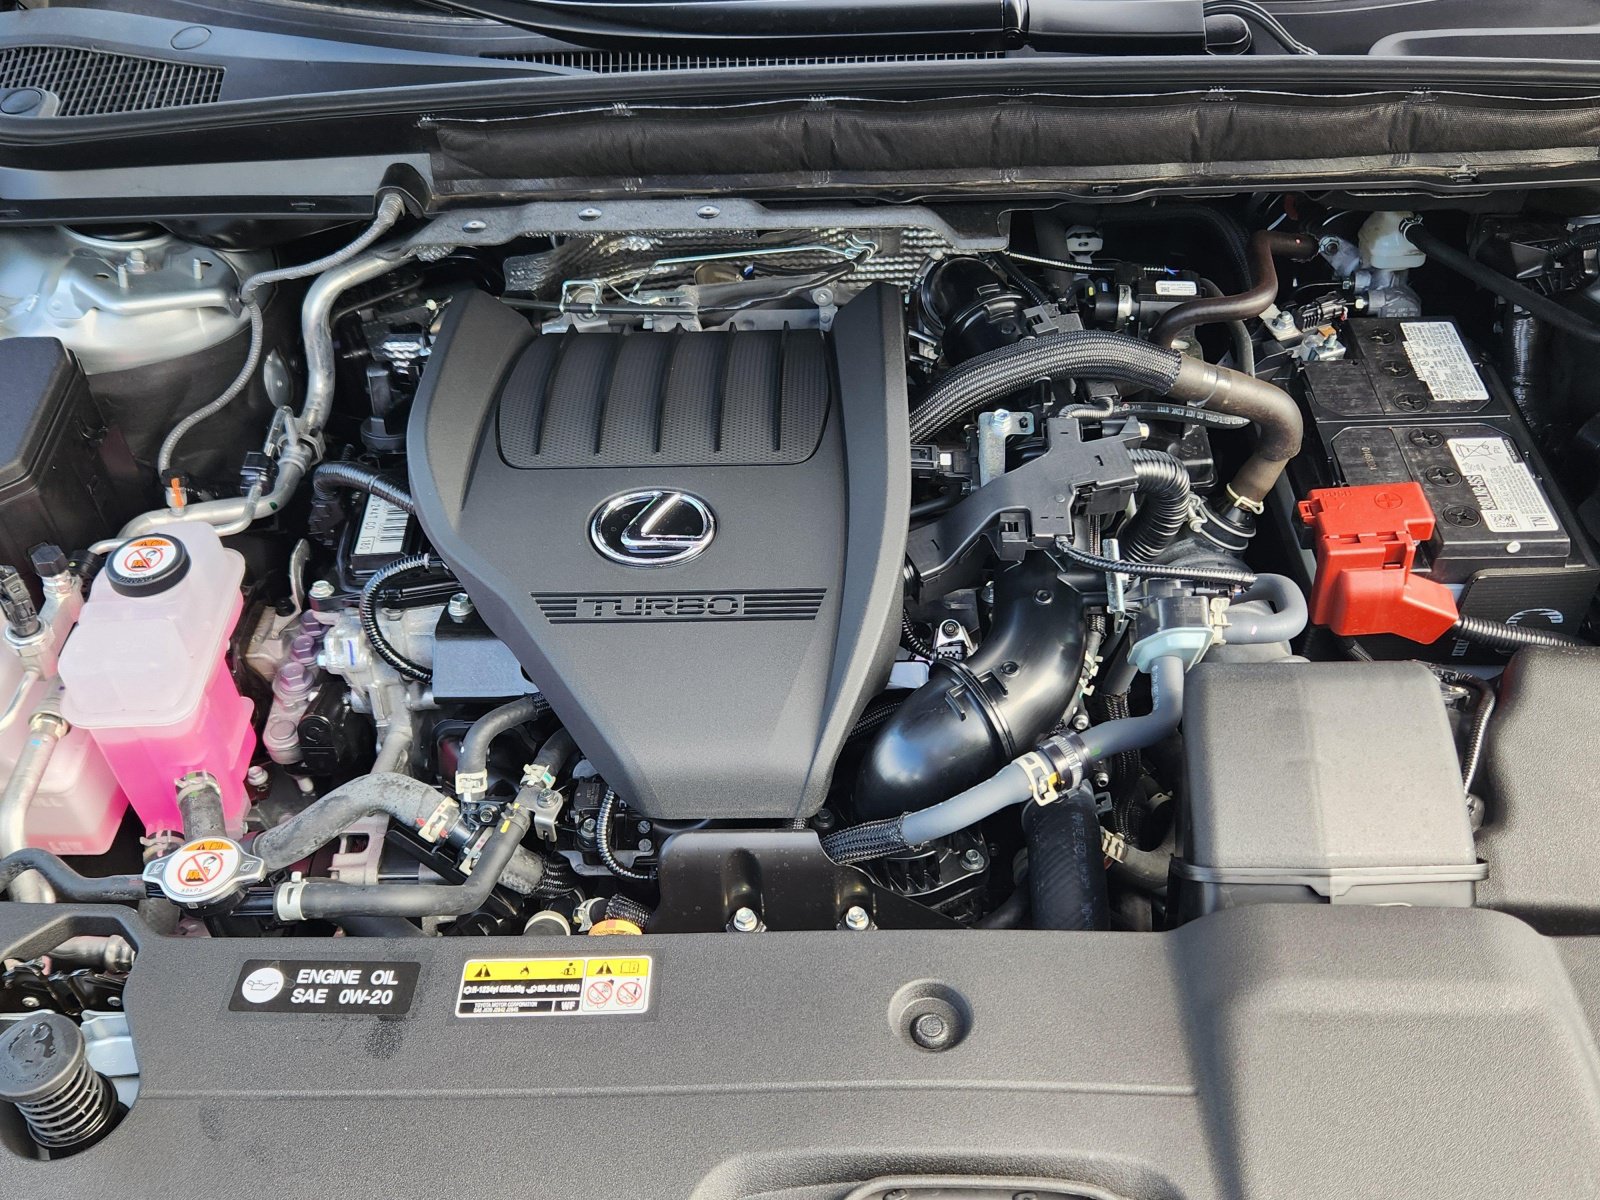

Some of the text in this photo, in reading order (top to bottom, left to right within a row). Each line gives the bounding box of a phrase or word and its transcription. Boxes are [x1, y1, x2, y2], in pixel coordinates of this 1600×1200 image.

[582, 595, 739, 616] TURBO
[296, 969, 399, 986] ENGINE OIL
[290, 989, 393, 1005] SAE 0W-20
[561, 1001, 576, 1010] WF
